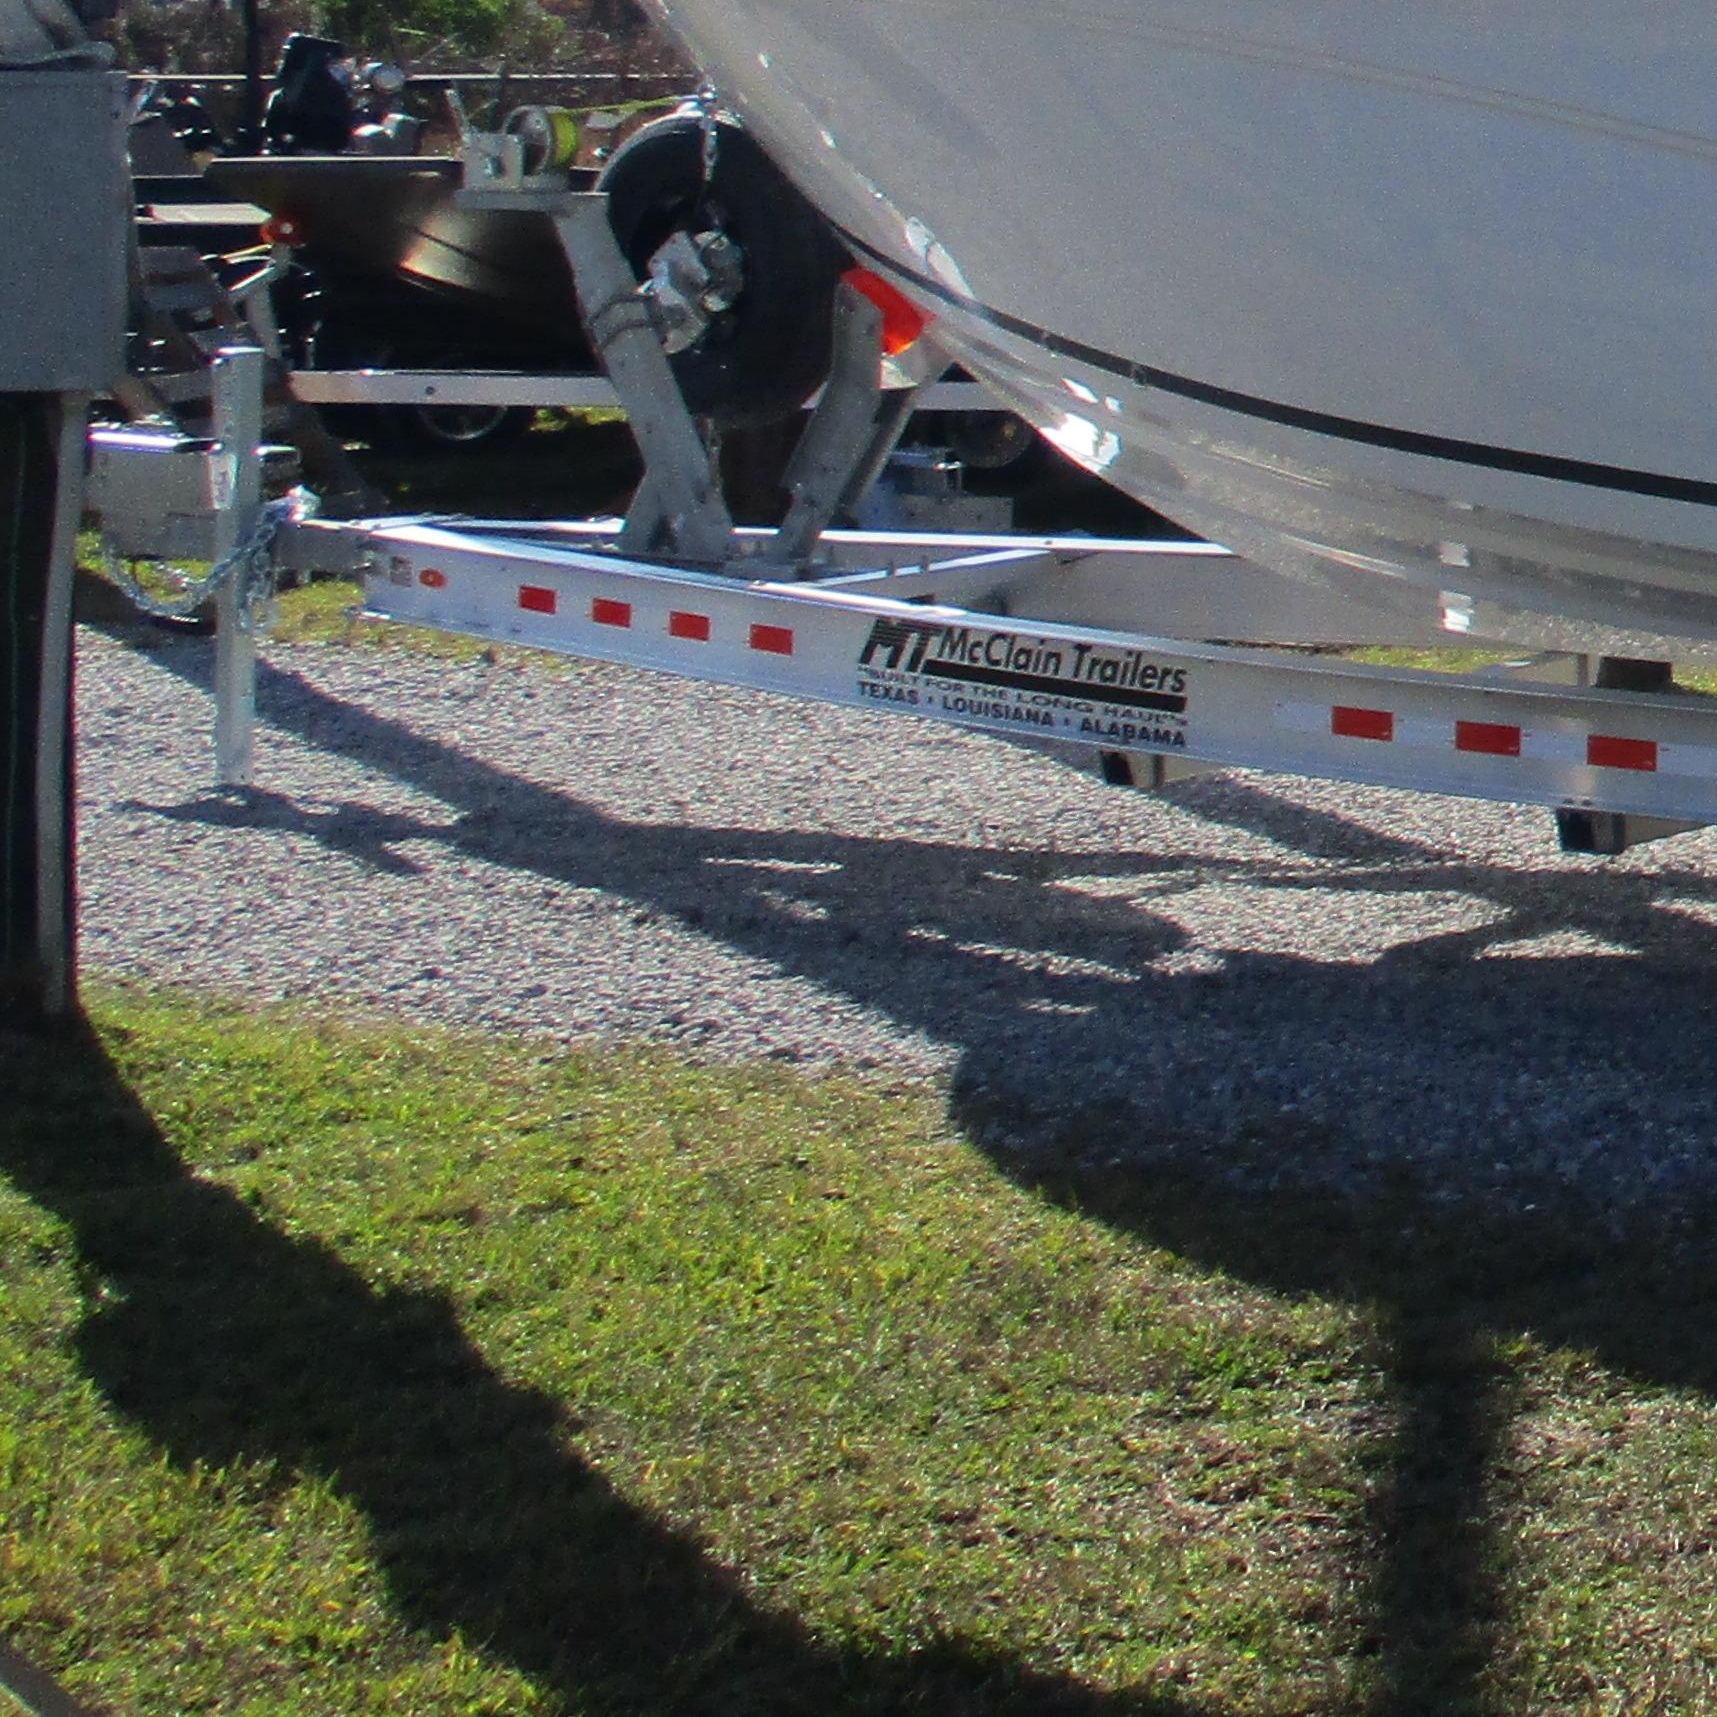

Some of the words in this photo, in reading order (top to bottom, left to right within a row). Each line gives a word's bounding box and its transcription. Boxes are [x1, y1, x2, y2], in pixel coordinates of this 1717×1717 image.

[938, 627, 1062, 675] McClain
[1073, 643, 1188, 693] Trailers
[859, 681, 920, 705] TEXAS
[943, 695, 1054, 727] LOUISIANA
[1081, 717, 1186, 747] ALABAMA
[926, 678, 963, 692] FOR
[974, 686, 1008, 701] THE
[1017, 693, 1094, 713] LONG
